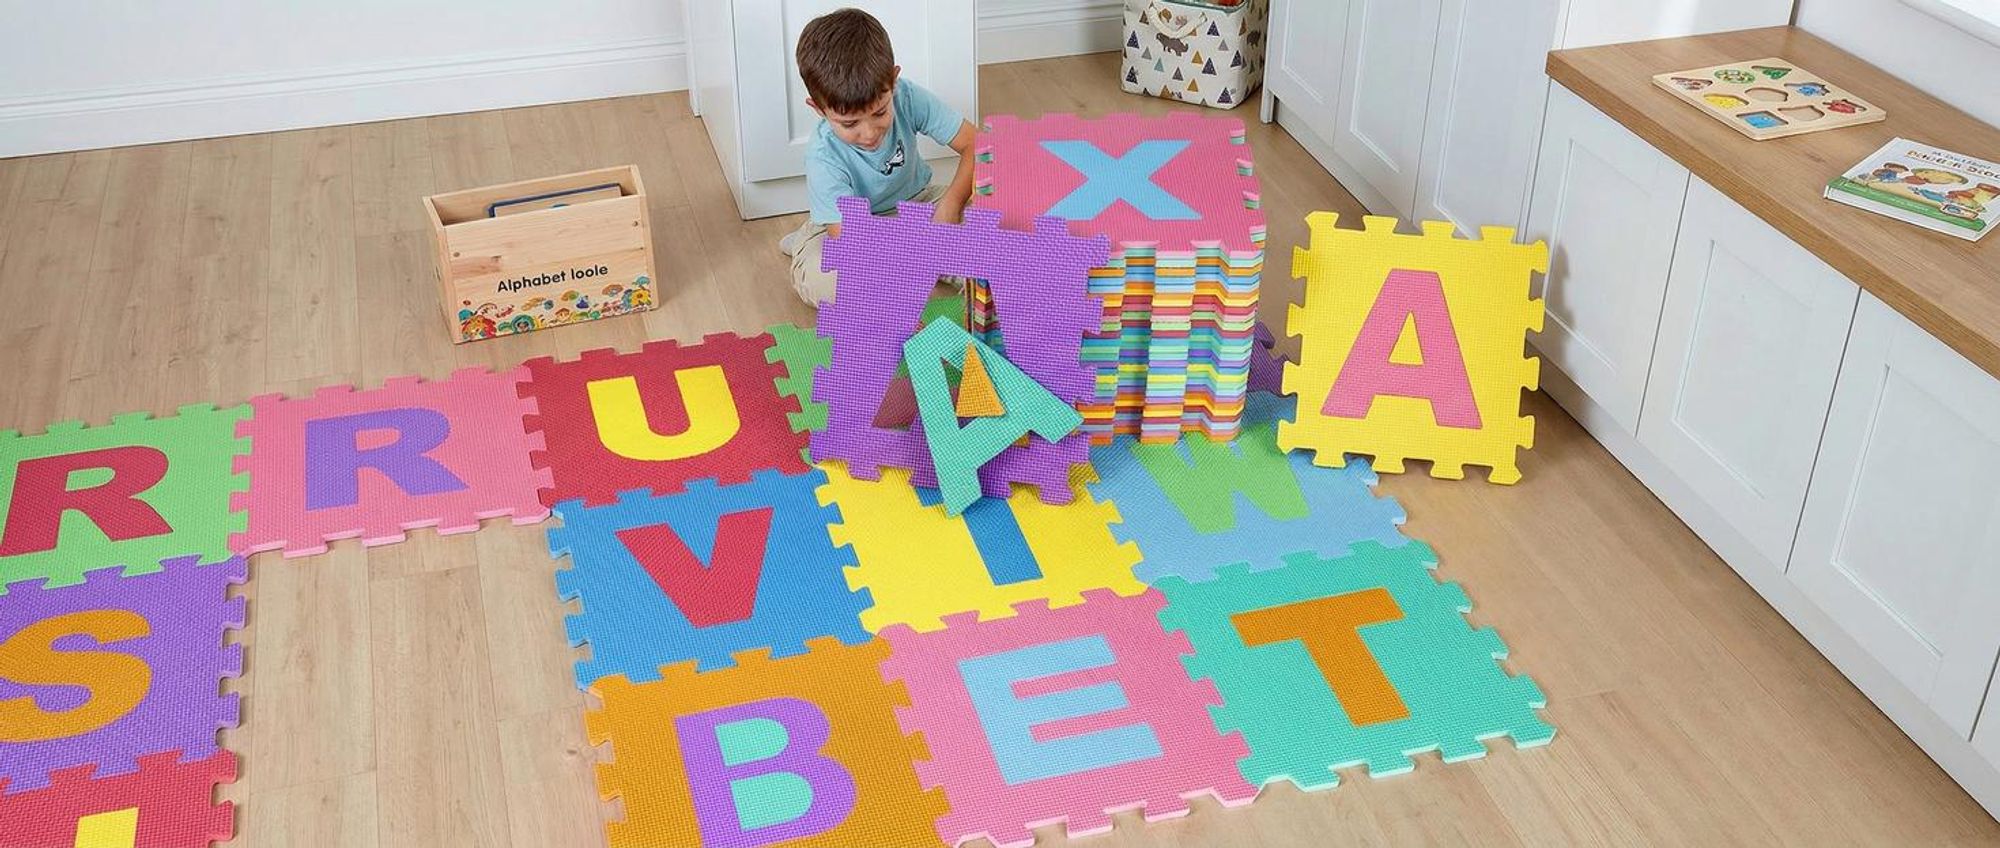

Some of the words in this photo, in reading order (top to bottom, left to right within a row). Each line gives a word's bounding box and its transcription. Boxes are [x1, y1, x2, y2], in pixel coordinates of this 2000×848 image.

[1038, 140, 1203, 220] X
[497, 270, 566, 293] Alphabet
[570, 264, 609, 280] loole
[1320, 268, 1483, 430] A
[305, 407, 470, 512] R
[587, 365, 741, 461] U
[903, 314, 1085, 519] A
[0, 445, 174, 558] R
[1128, 422, 1313, 535] W
[614, 507, 775, 629] V
[0, 609, 153, 743] S
[957, 634, 1164, 786] E
[1230, 587, 1412, 728] T
[675, 697, 858, 848] B
